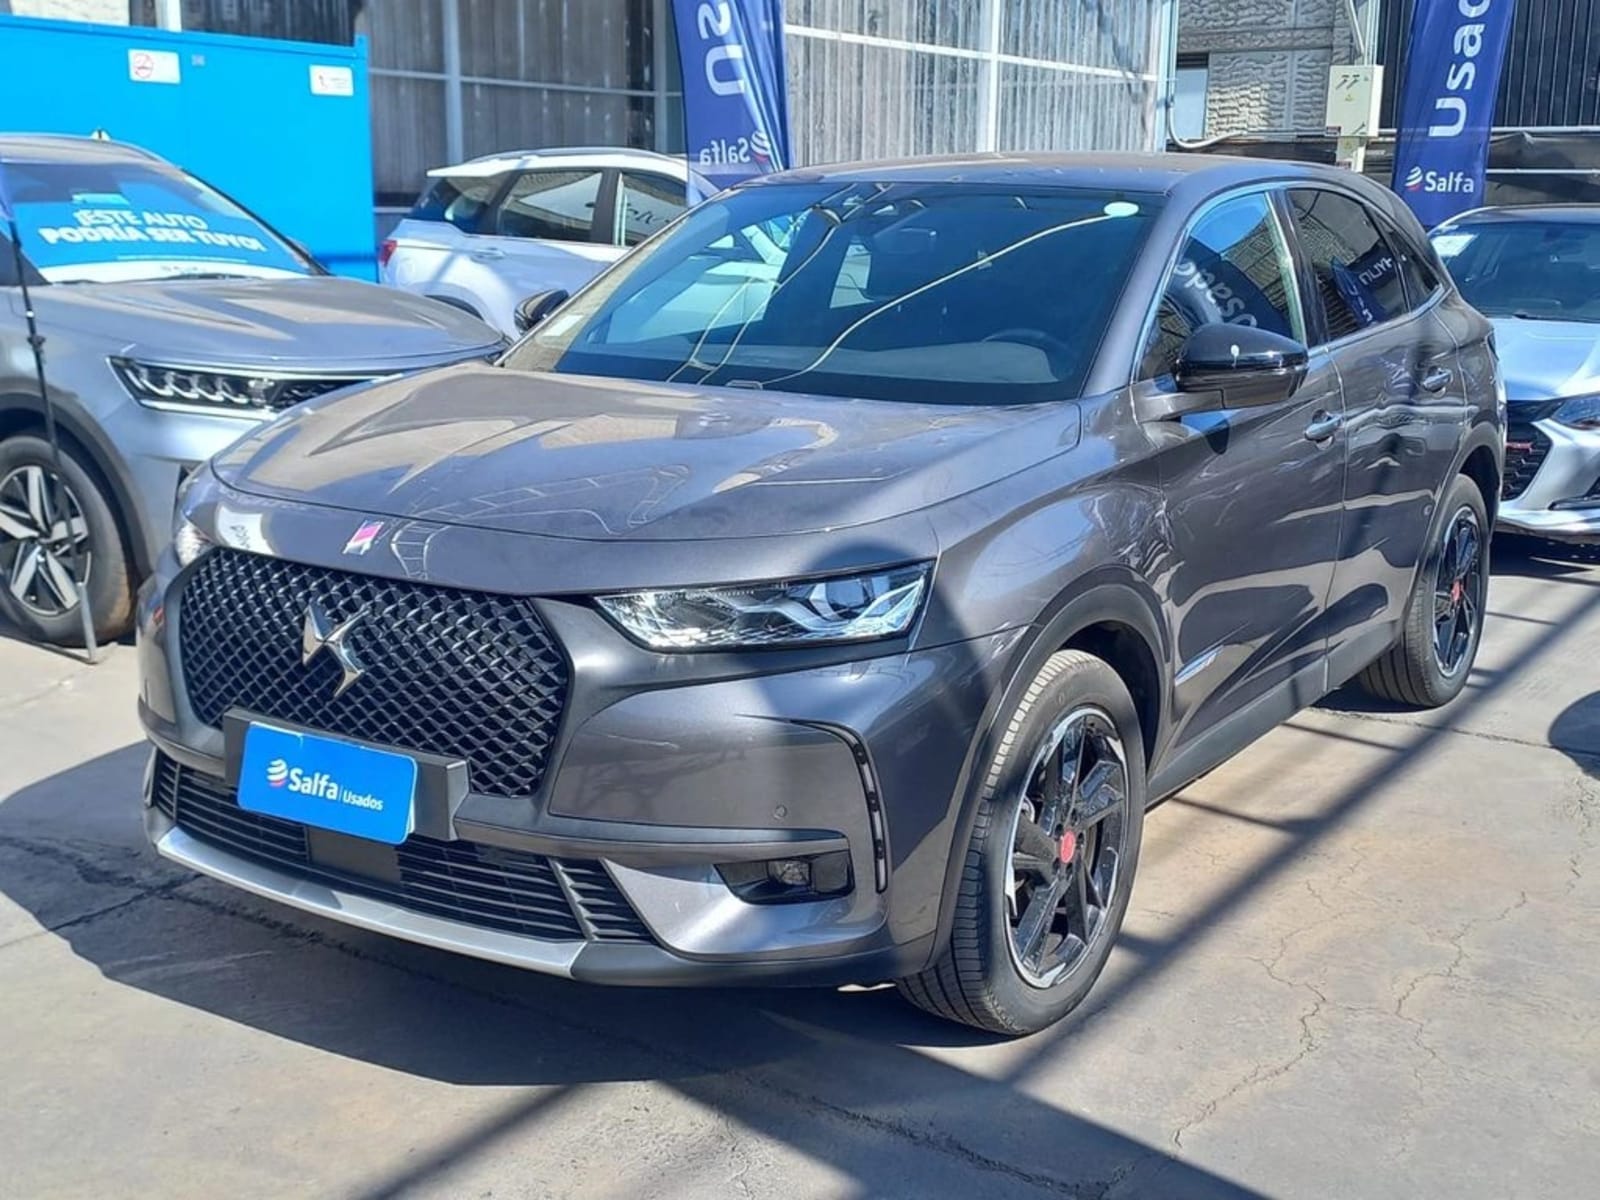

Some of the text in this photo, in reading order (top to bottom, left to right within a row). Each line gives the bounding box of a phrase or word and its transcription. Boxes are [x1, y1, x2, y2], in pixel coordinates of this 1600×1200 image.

[1424, 170, 1475, 194] Salfa
[142, 210, 209, 232] AUTO
[145, 226, 198, 244] SER
[288, 766, 384, 812] Salfa Usados
